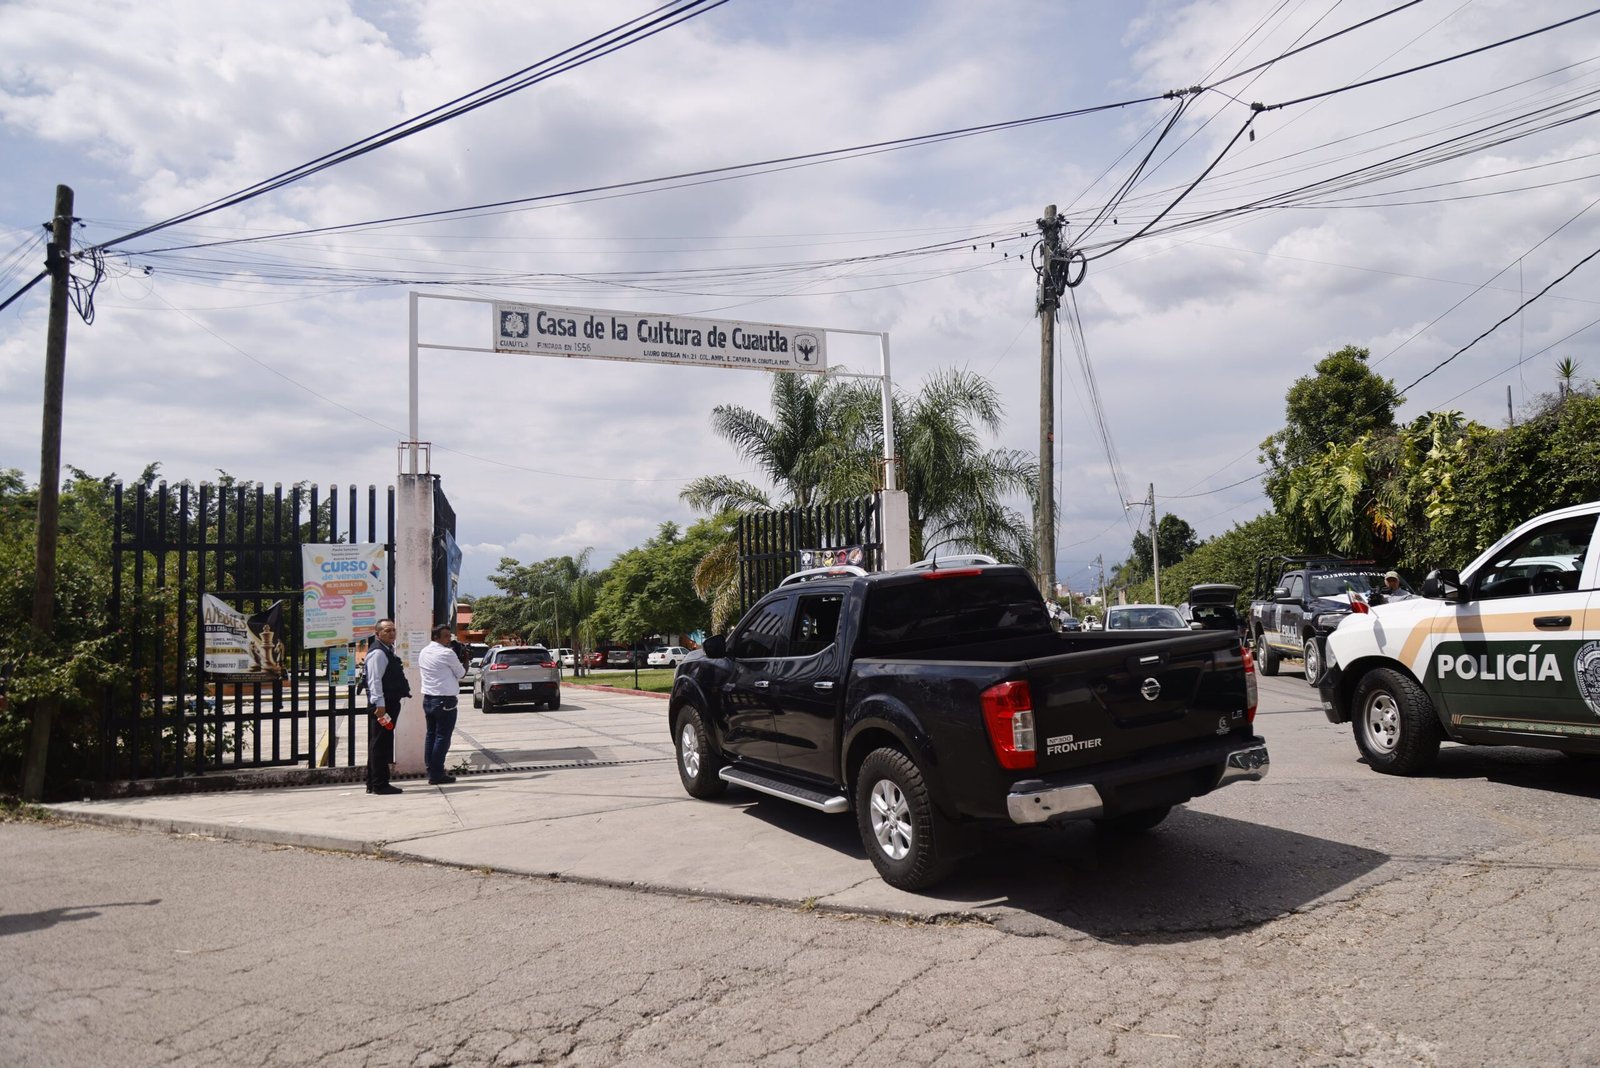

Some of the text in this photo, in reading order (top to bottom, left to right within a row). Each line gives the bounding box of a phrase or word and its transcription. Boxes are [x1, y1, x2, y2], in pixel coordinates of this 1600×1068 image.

[537, 311, 788, 353] Casa de la Cultura de Cuautla
[500, 339, 529, 348] CUAUTLA
[321, 561, 368, 573] CURSO
[1437, 644, 1563, 682] POLICÍA
[1046, 738, 1103, 756] FRONTIER
